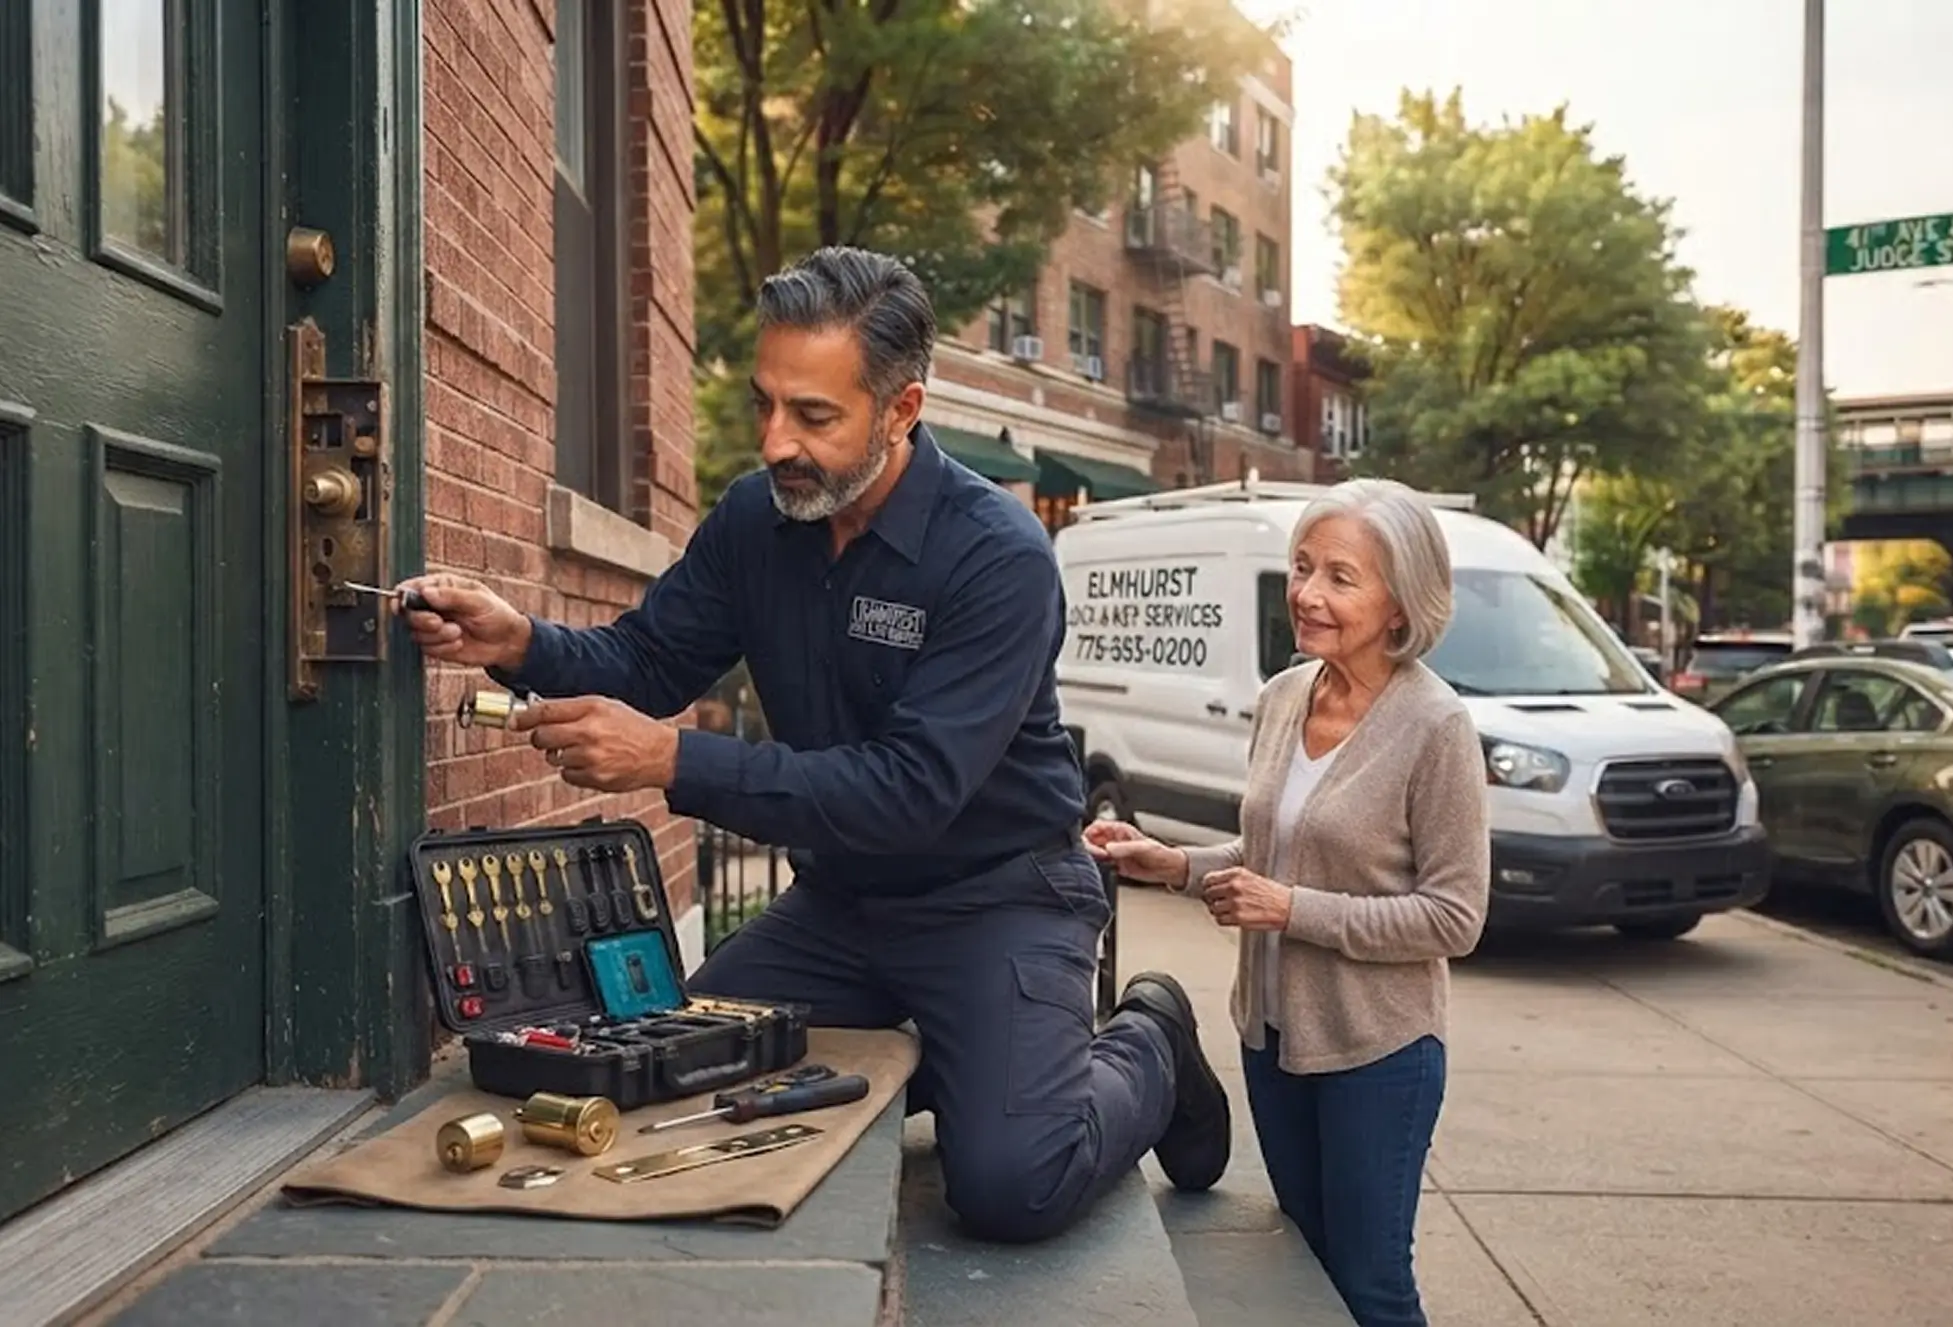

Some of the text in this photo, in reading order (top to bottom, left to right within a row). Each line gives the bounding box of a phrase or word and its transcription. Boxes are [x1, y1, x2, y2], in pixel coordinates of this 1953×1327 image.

[1849, 239, 1953, 271] JUDGE S
[1087, 567, 1198, 599] ELMHURST
[1144, 603, 1223, 628] SERVICES
